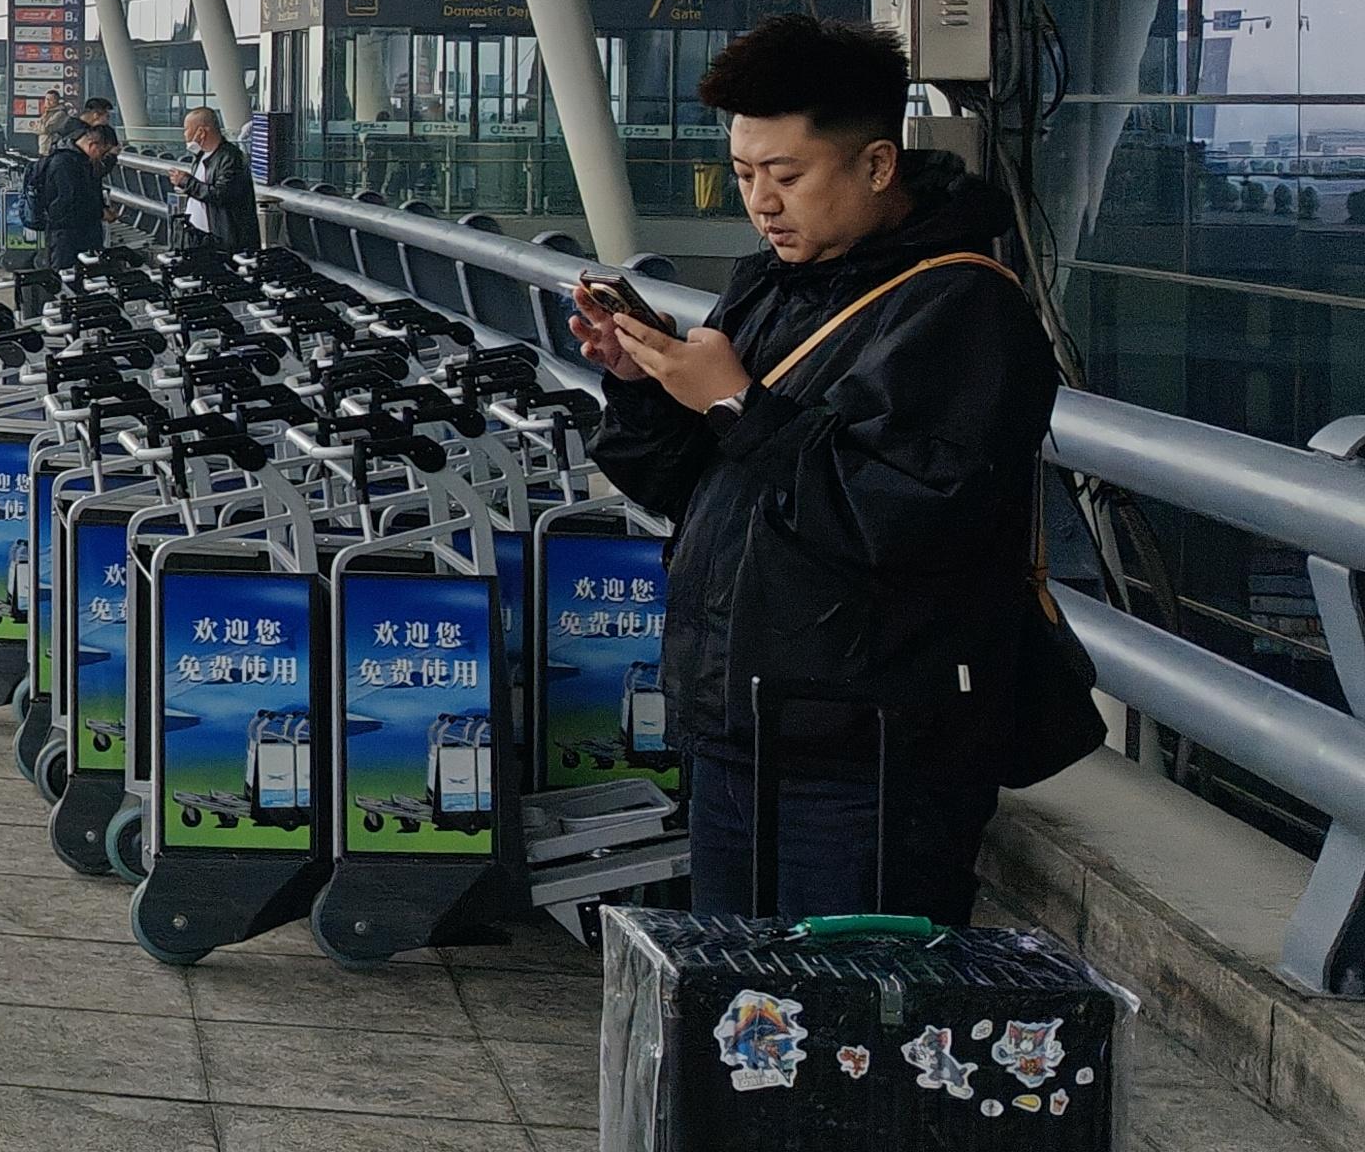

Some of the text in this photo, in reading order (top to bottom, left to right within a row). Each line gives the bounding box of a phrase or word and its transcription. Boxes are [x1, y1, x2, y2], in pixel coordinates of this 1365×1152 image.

[443, 5, 503, 17] Domestic
[670, 8, 702, 20] Gate
[572, 576, 655, 603] 欢迎您
[191, 617, 282, 646] 欢迎您
[372, 620, 463, 649] 欢迎您
[557, 610, 666, 639] 免费使用
[175, 654, 298, 685] 免费使用
[357, 658, 478, 689] 免费使用
